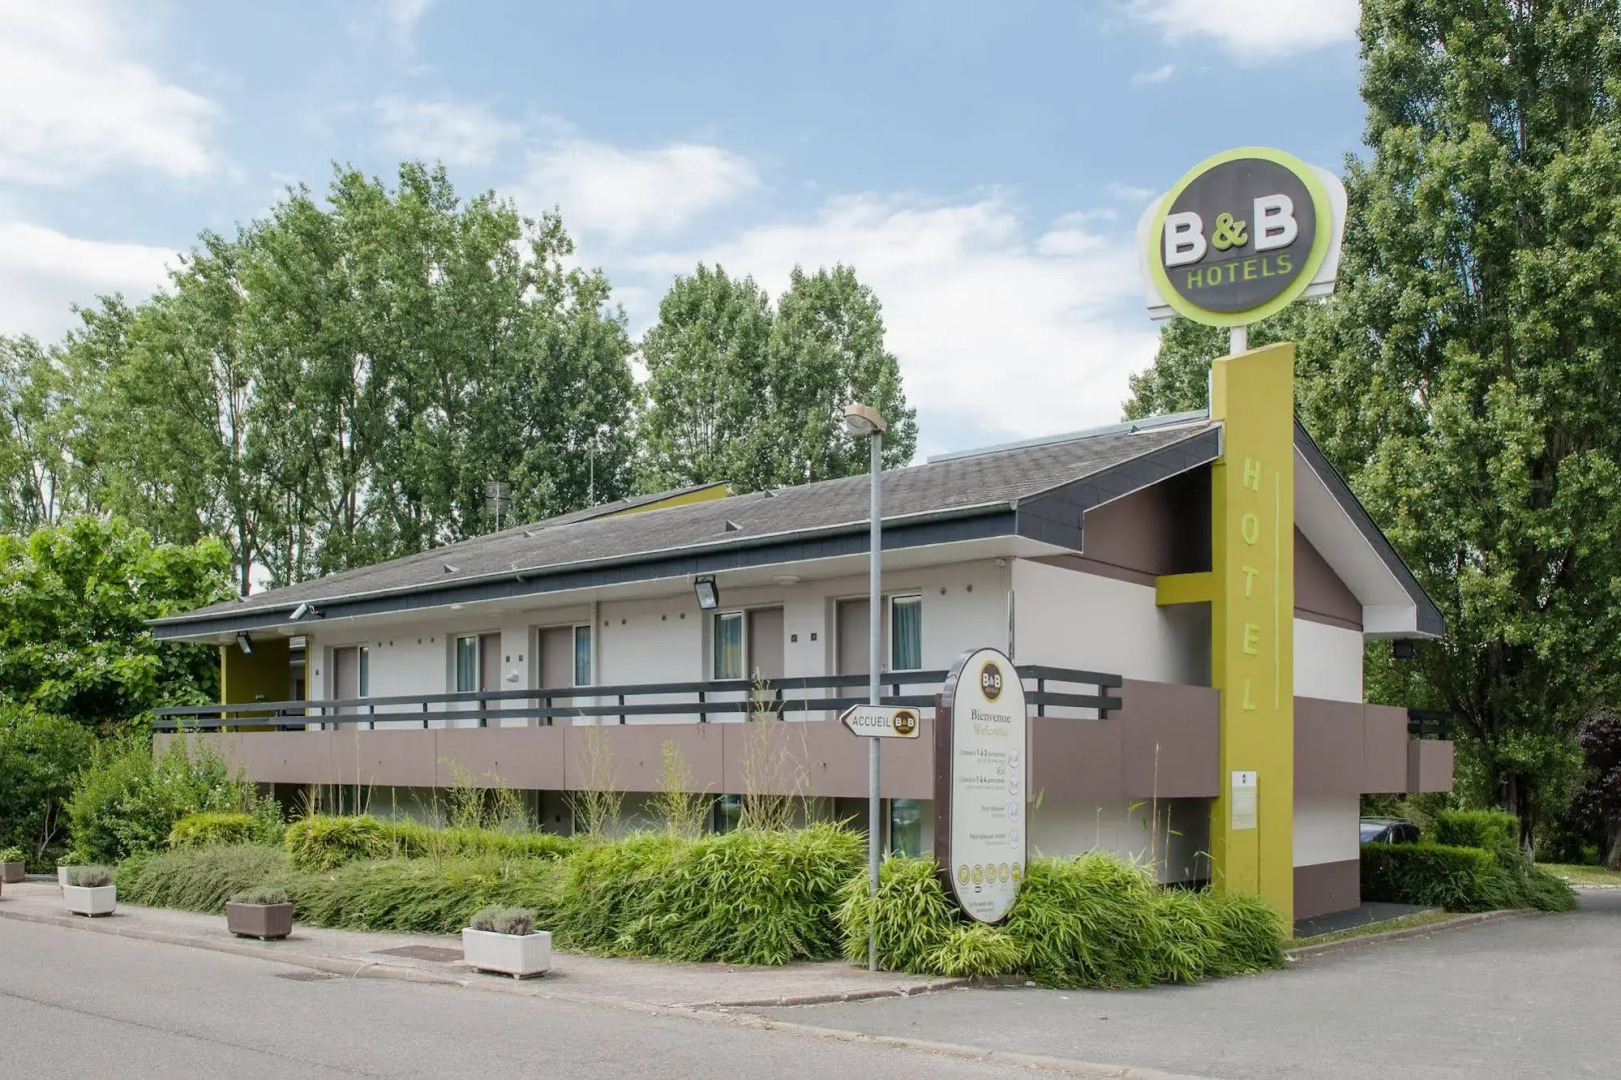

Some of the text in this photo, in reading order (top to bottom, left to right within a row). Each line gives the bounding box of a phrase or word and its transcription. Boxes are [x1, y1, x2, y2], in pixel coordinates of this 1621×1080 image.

[1165, 194, 1298, 268] B&B
[1186, 254, 1293, 290] HOTELS
[1241, 457, 1261, 711] HOTEL
[982, 672, 1001, 688] B&B
[852, 715, 891, 728] ACCUEIL
[971, 708, 1012, 724] Bienvenue
